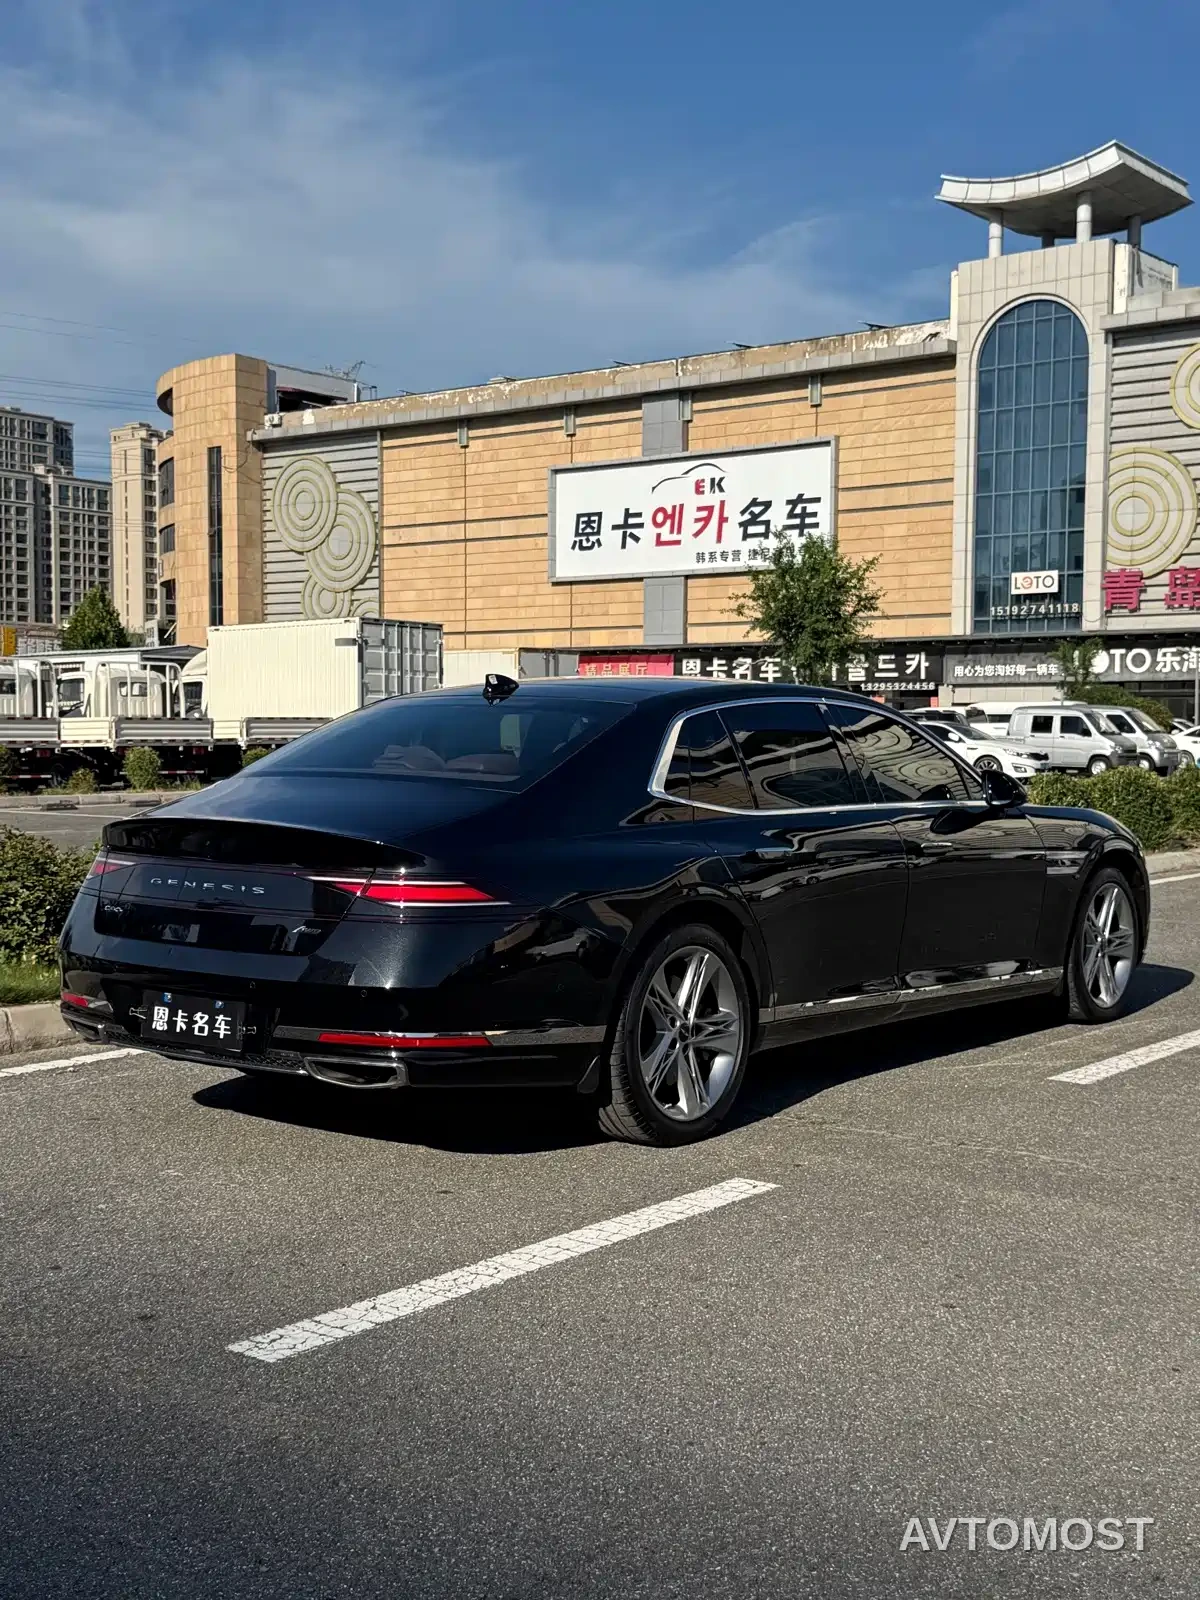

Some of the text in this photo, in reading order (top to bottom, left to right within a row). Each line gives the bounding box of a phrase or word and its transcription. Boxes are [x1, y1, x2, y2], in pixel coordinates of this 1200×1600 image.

[694, 476, 726, 496] EK
[695, 549, 742, 564] 韩系专营
[1014, 575, 1055, 590] LOTO
[990, 602, 1079, 616] 15192741118
[860, 682, 936, 691] 13295324456
[150, 877, 265, 894] GENESIS
[152, 1005, 232, 1039] 恩卡名车
